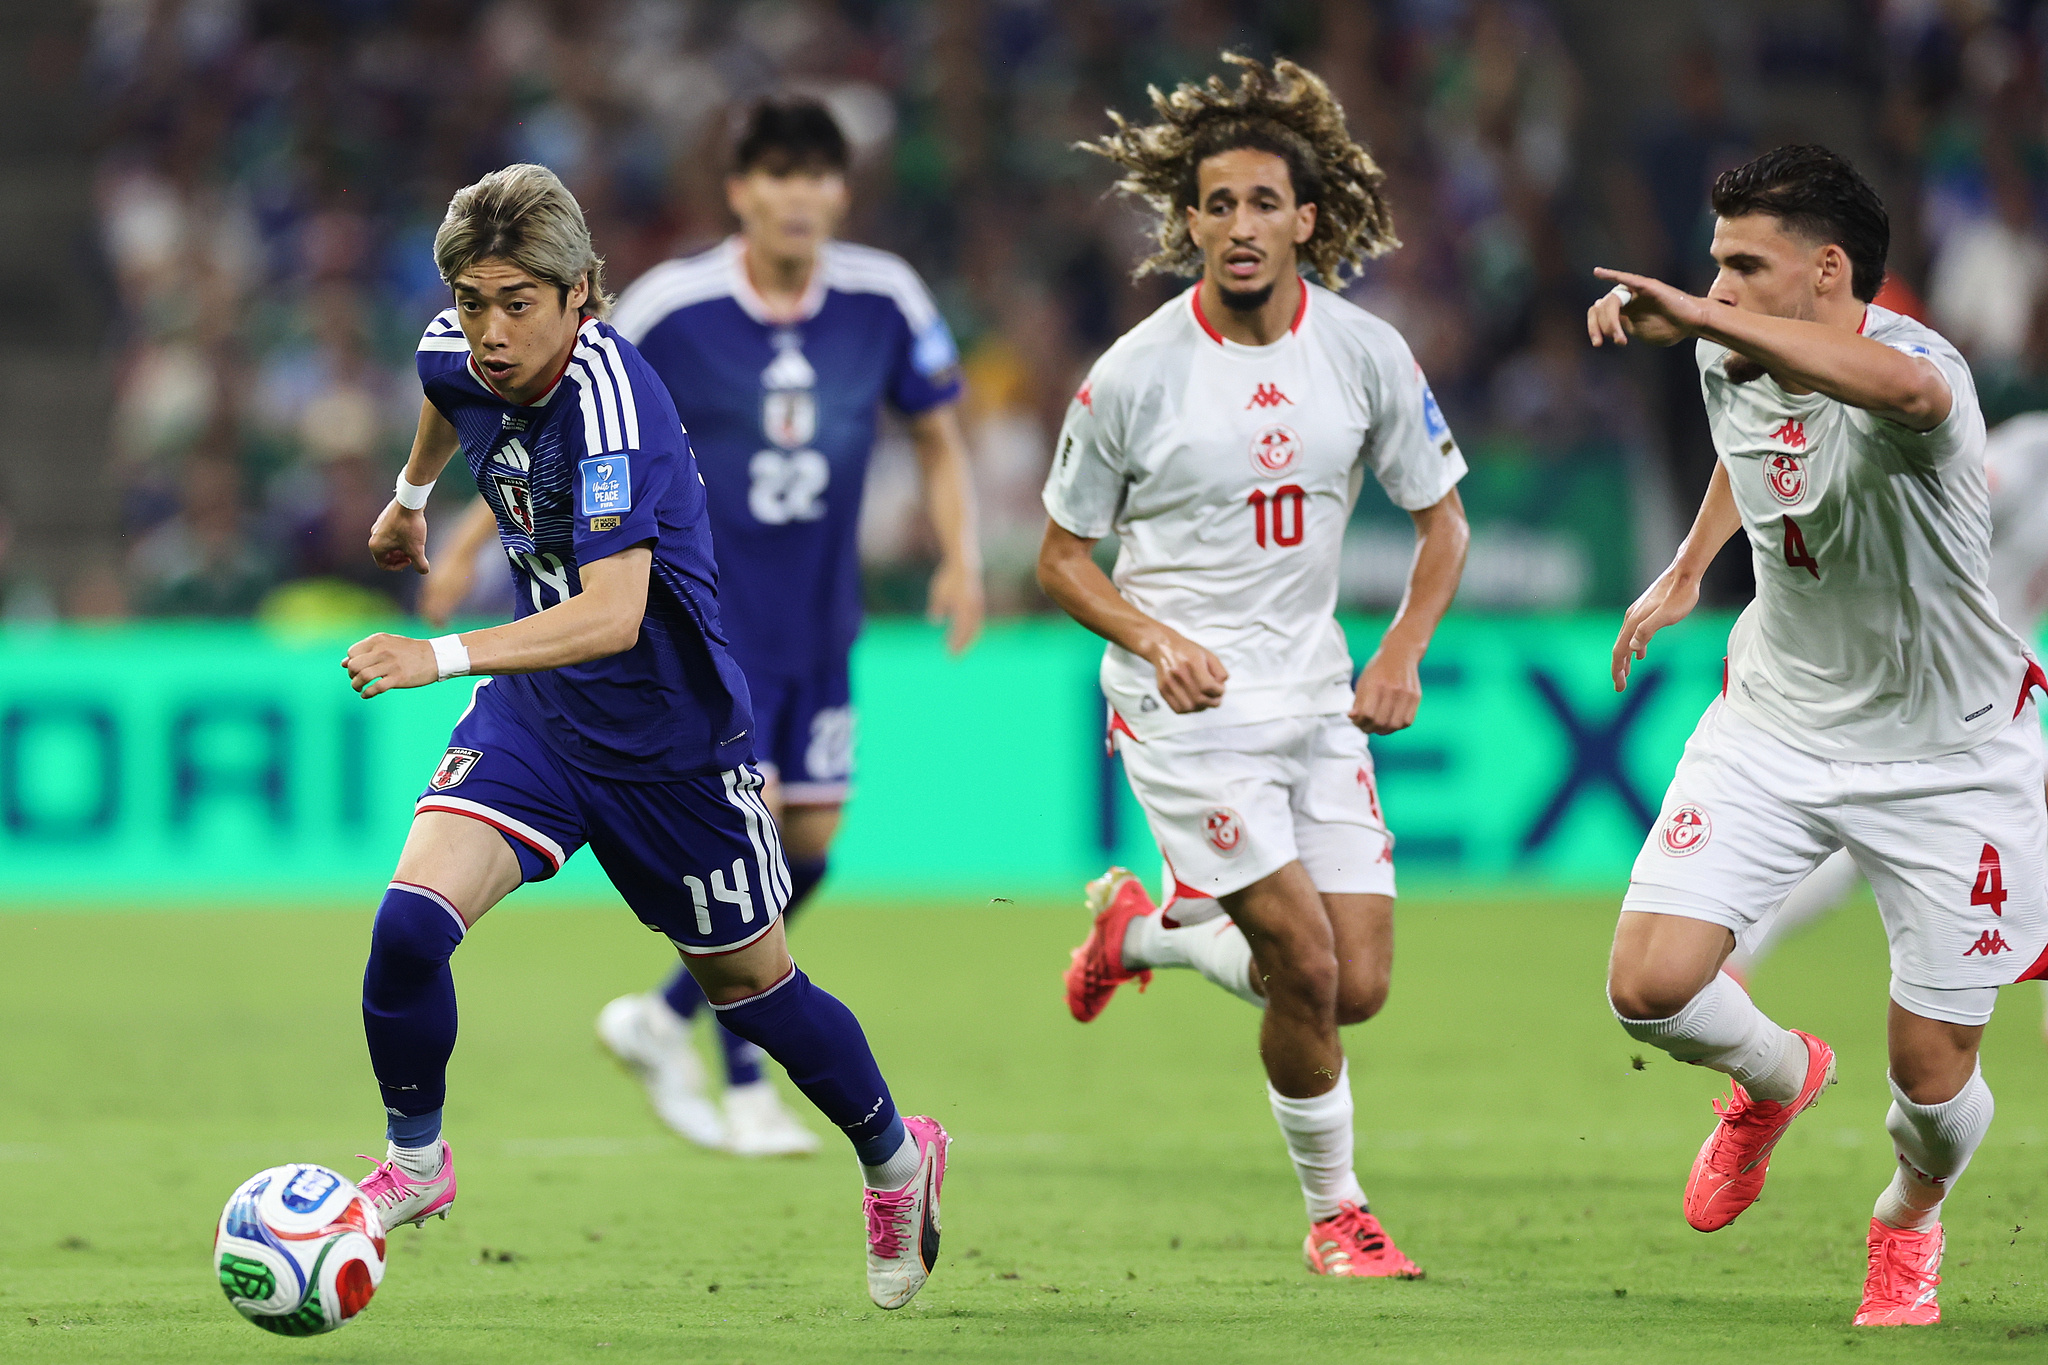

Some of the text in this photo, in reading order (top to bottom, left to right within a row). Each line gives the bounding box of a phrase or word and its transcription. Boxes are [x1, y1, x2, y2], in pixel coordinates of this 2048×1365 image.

[594, 490, 619, 502] PEACE
[748, 448, 831, 526] 22
[1247, 484, 1306, 551] 10
[507, 546, 571, 613] 14
[1782, 513, 1821, 581] 4
[682, 857, 756, 936] 14
[1969, 842, 2008, 918] 4
